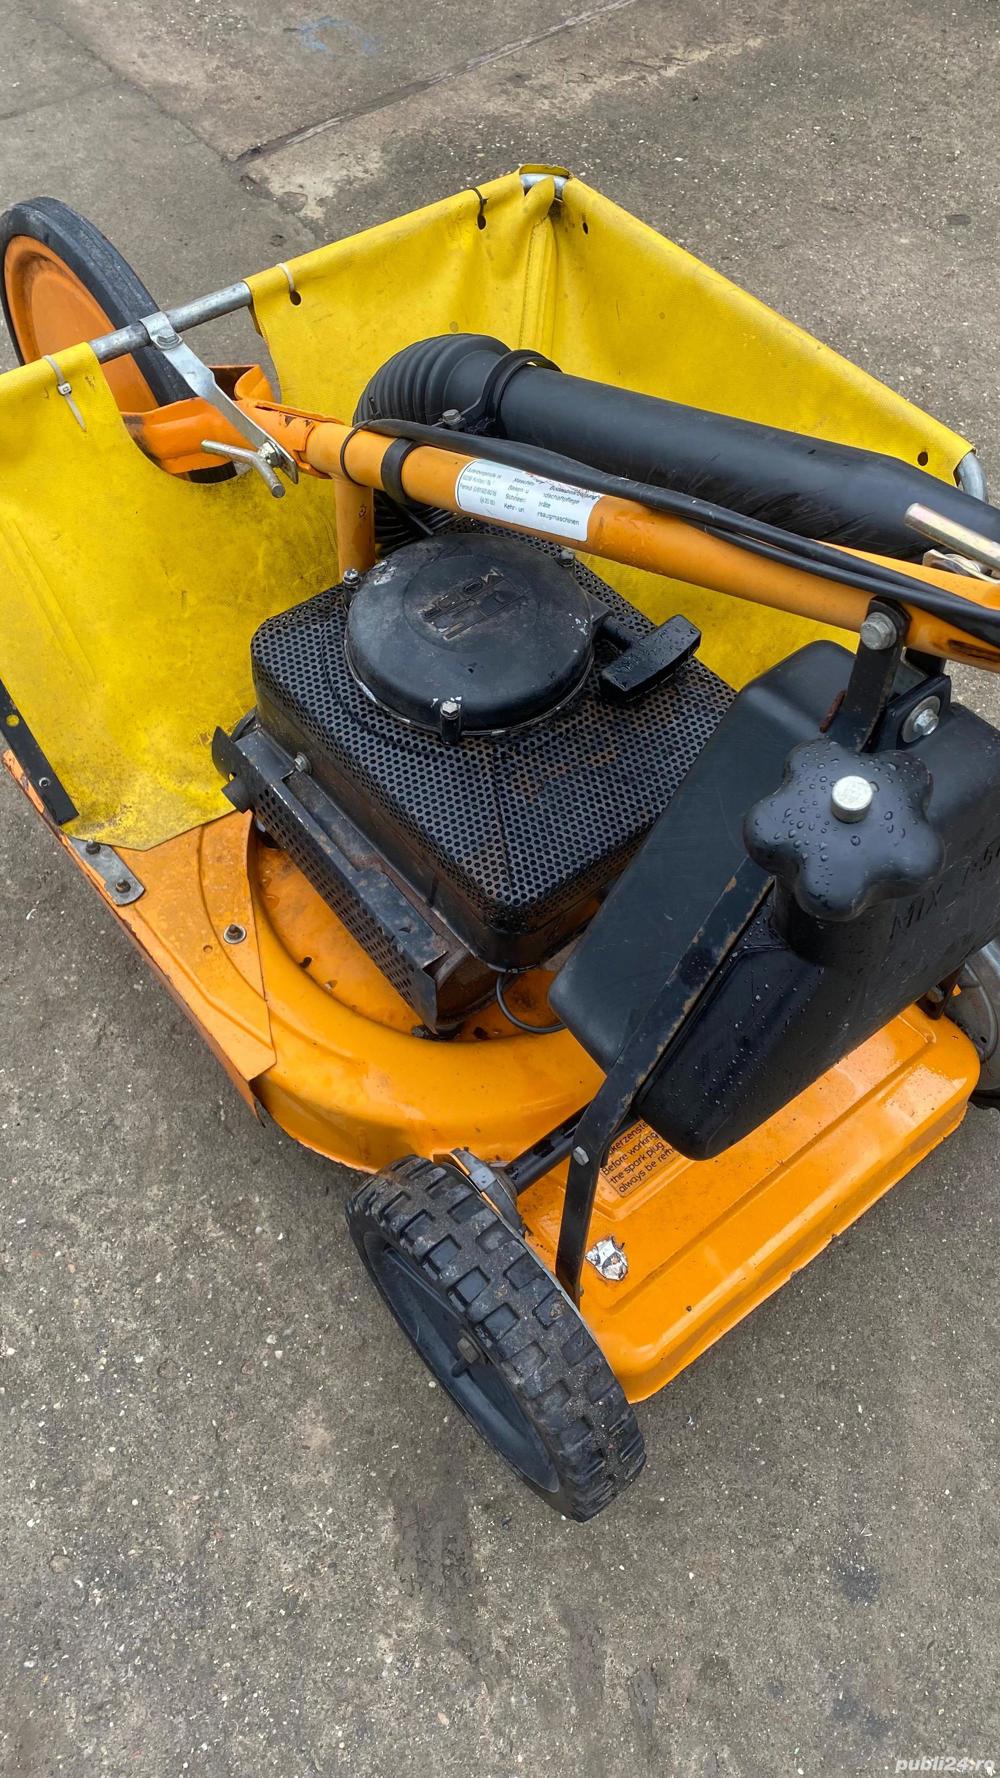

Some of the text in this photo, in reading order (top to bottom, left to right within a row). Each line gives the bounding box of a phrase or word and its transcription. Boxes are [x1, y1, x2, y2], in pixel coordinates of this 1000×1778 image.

[601, 1130, 660, 1177] Before working
[609, 1140, 665, 1185] the spark plug
[618, 1168, 647, 1193] always
[645, 1160, 657, 1172] be
